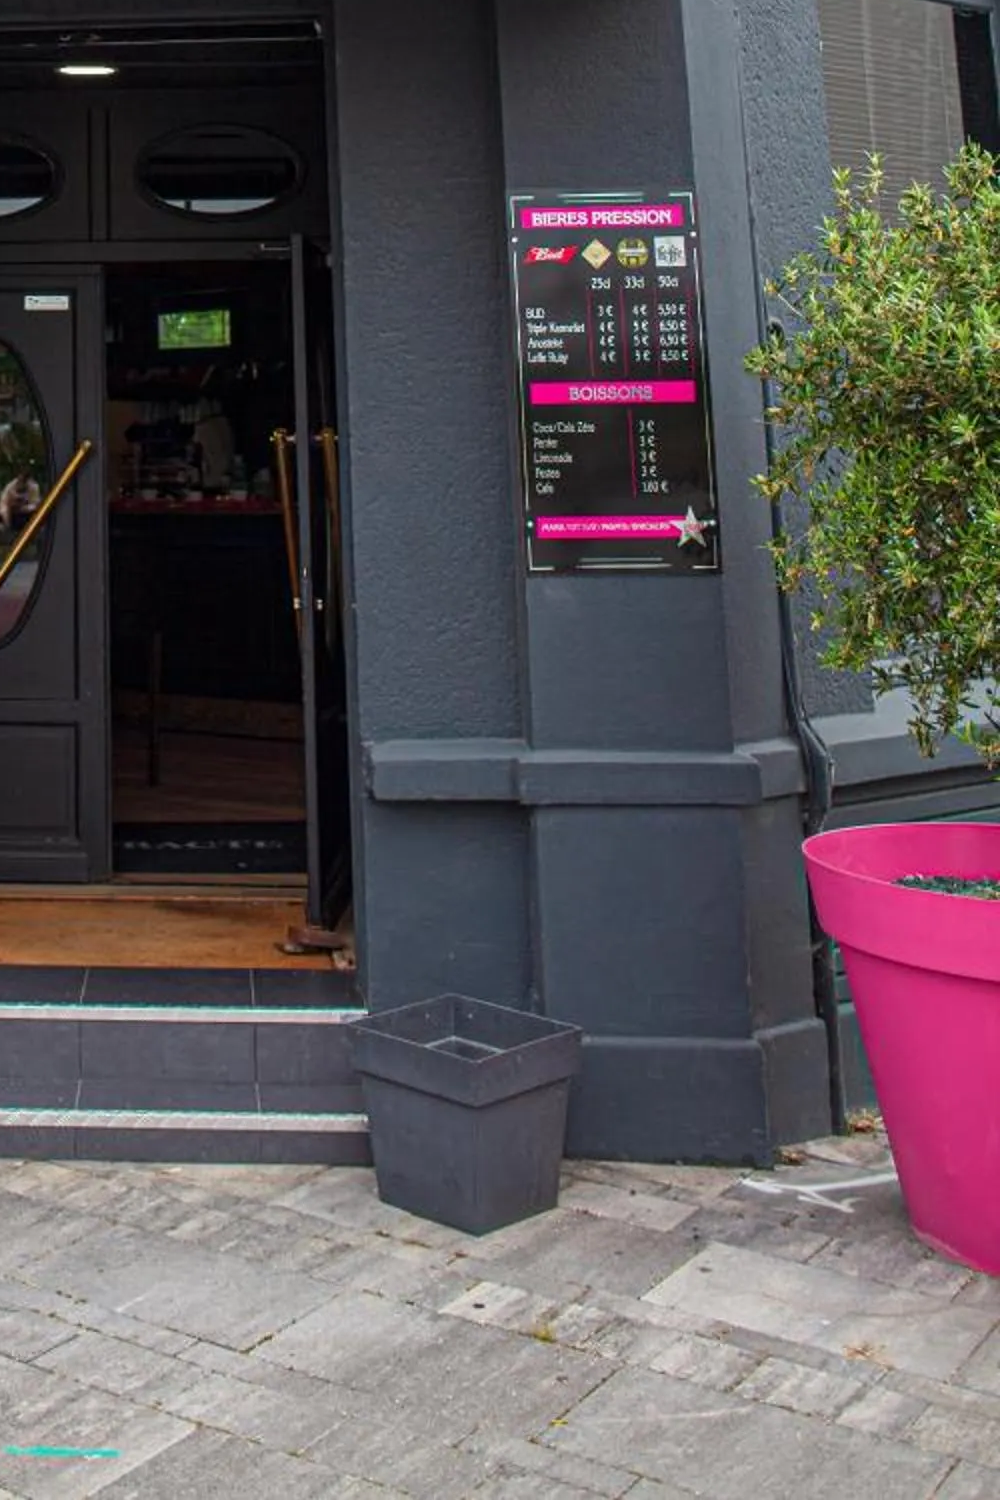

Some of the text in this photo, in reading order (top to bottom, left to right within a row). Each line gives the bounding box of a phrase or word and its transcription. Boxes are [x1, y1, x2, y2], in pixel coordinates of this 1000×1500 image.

[531, 209, 672, 227] BIERES PRESSION
[568, 386, 653, 401] BOISSONS
